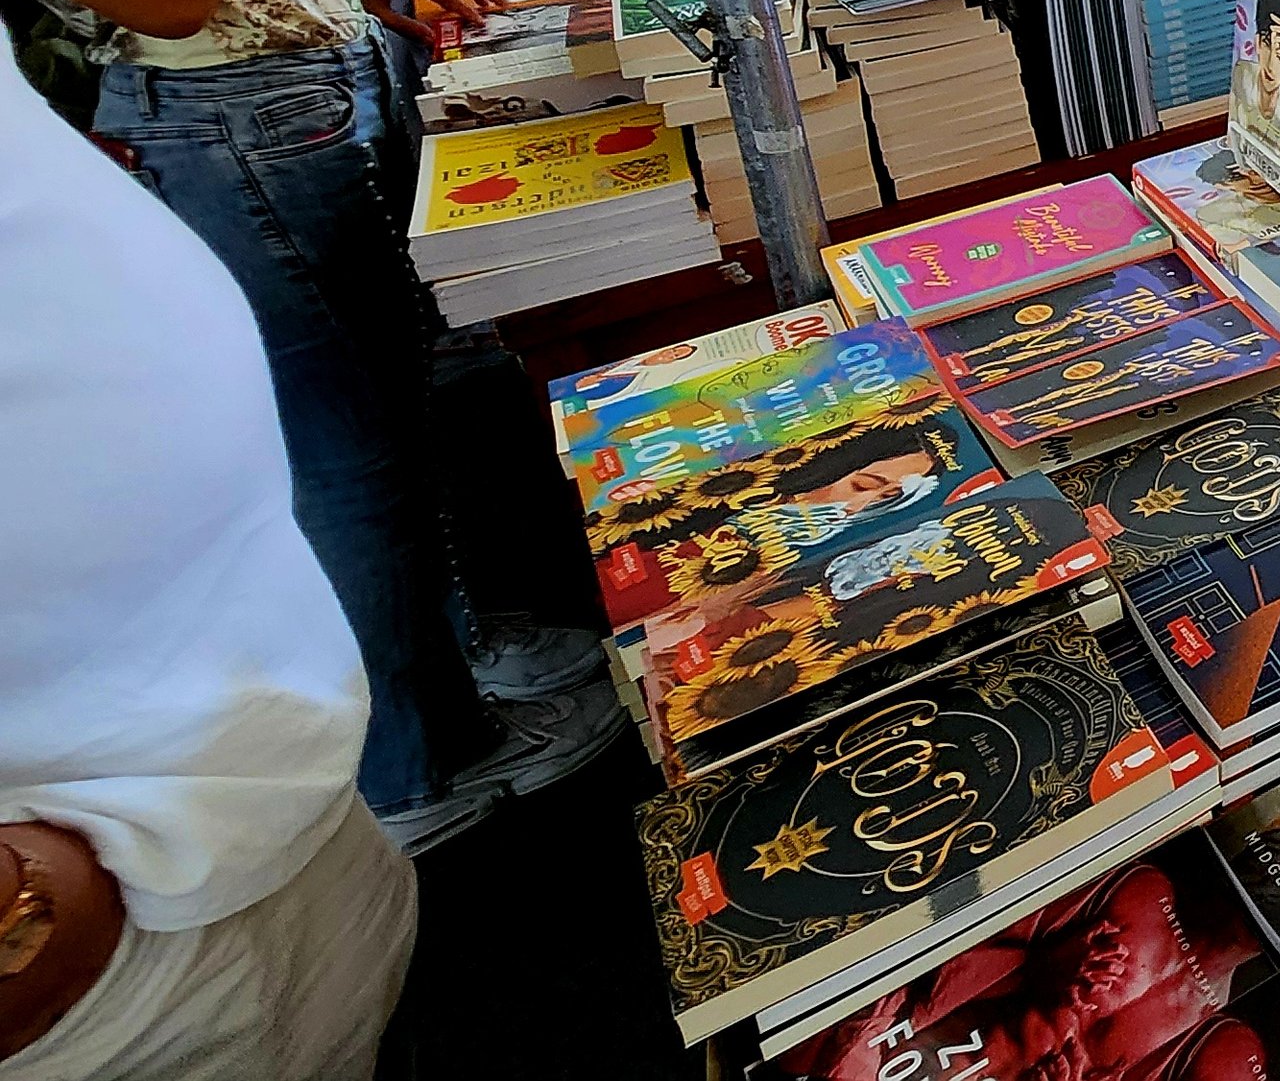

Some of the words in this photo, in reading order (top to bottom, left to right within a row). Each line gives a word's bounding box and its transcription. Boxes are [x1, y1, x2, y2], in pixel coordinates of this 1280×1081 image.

[1026, 202, 1094, 254] Beautiful
[1109, 287, 1180, 324] THIS
[764, 320, 788, 351] Boome
[783, 316, 831, 348] OK
[766, 379, 812, 432] WITH
[692, 409, 735, 453] THE
[1157, 895, 1191, 954] FORTEJO
